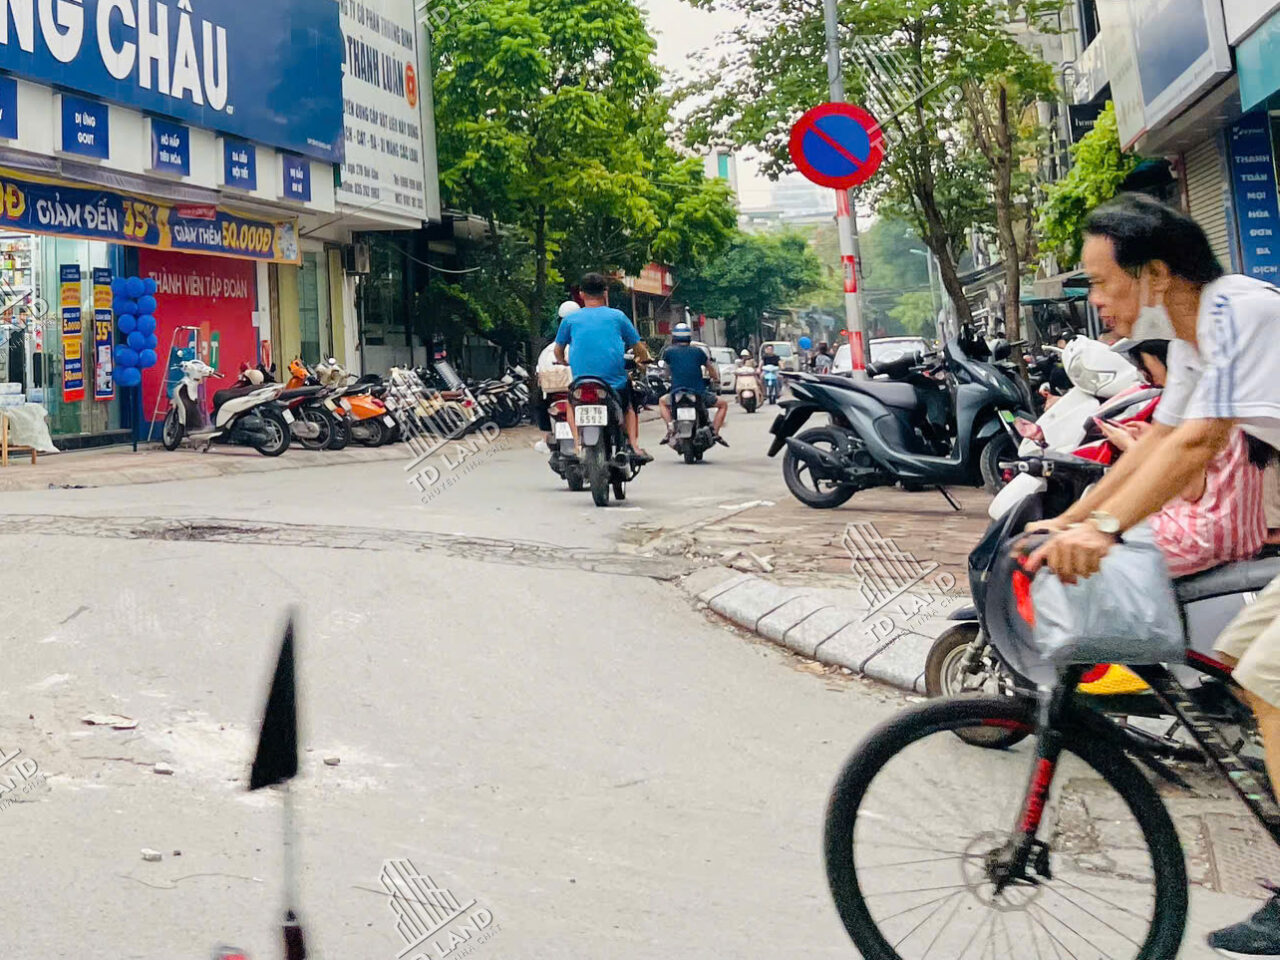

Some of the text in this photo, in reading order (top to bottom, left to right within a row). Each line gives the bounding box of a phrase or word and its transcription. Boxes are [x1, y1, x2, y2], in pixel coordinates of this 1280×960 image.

[1235, 155, 1270, 164] THANH
[1247, 191, 1266, 200] MỌI
[36, 192, 81, 227] GIẢM
[84, 199, 118, 232] ĐẾN
[222, 222, 272, 252] 50.000Đ
[149, 267, 248, 303] THÀNH VIÊN TẬP ĐOÀN
